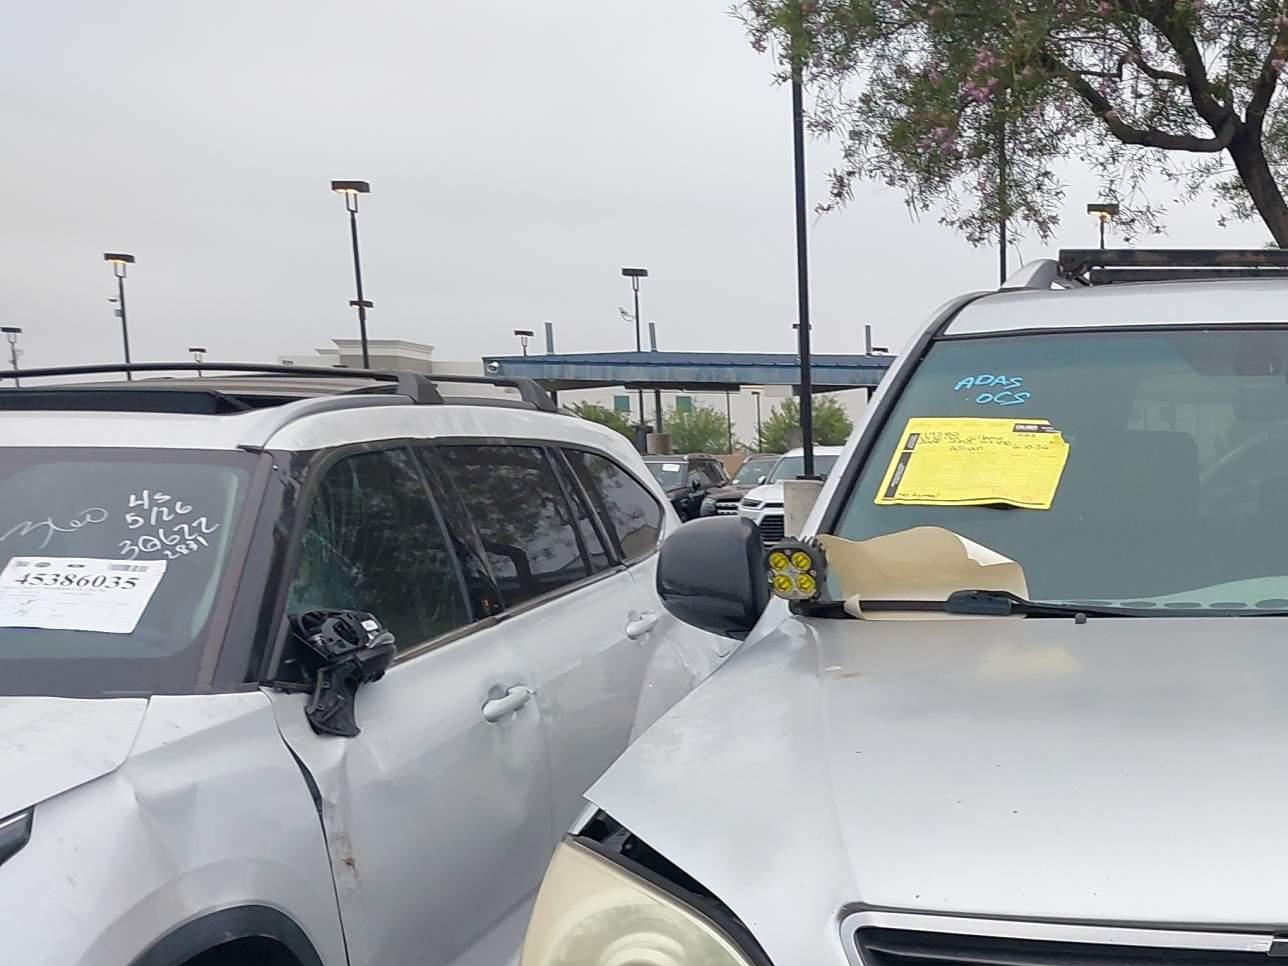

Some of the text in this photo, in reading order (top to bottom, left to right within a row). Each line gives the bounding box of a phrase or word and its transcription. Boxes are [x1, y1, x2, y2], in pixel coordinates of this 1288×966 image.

[953, 374, 1024, 391] ADAS
[975, 391, 1031, 406] OCS
[15, 572, 140, 590] 45386035
